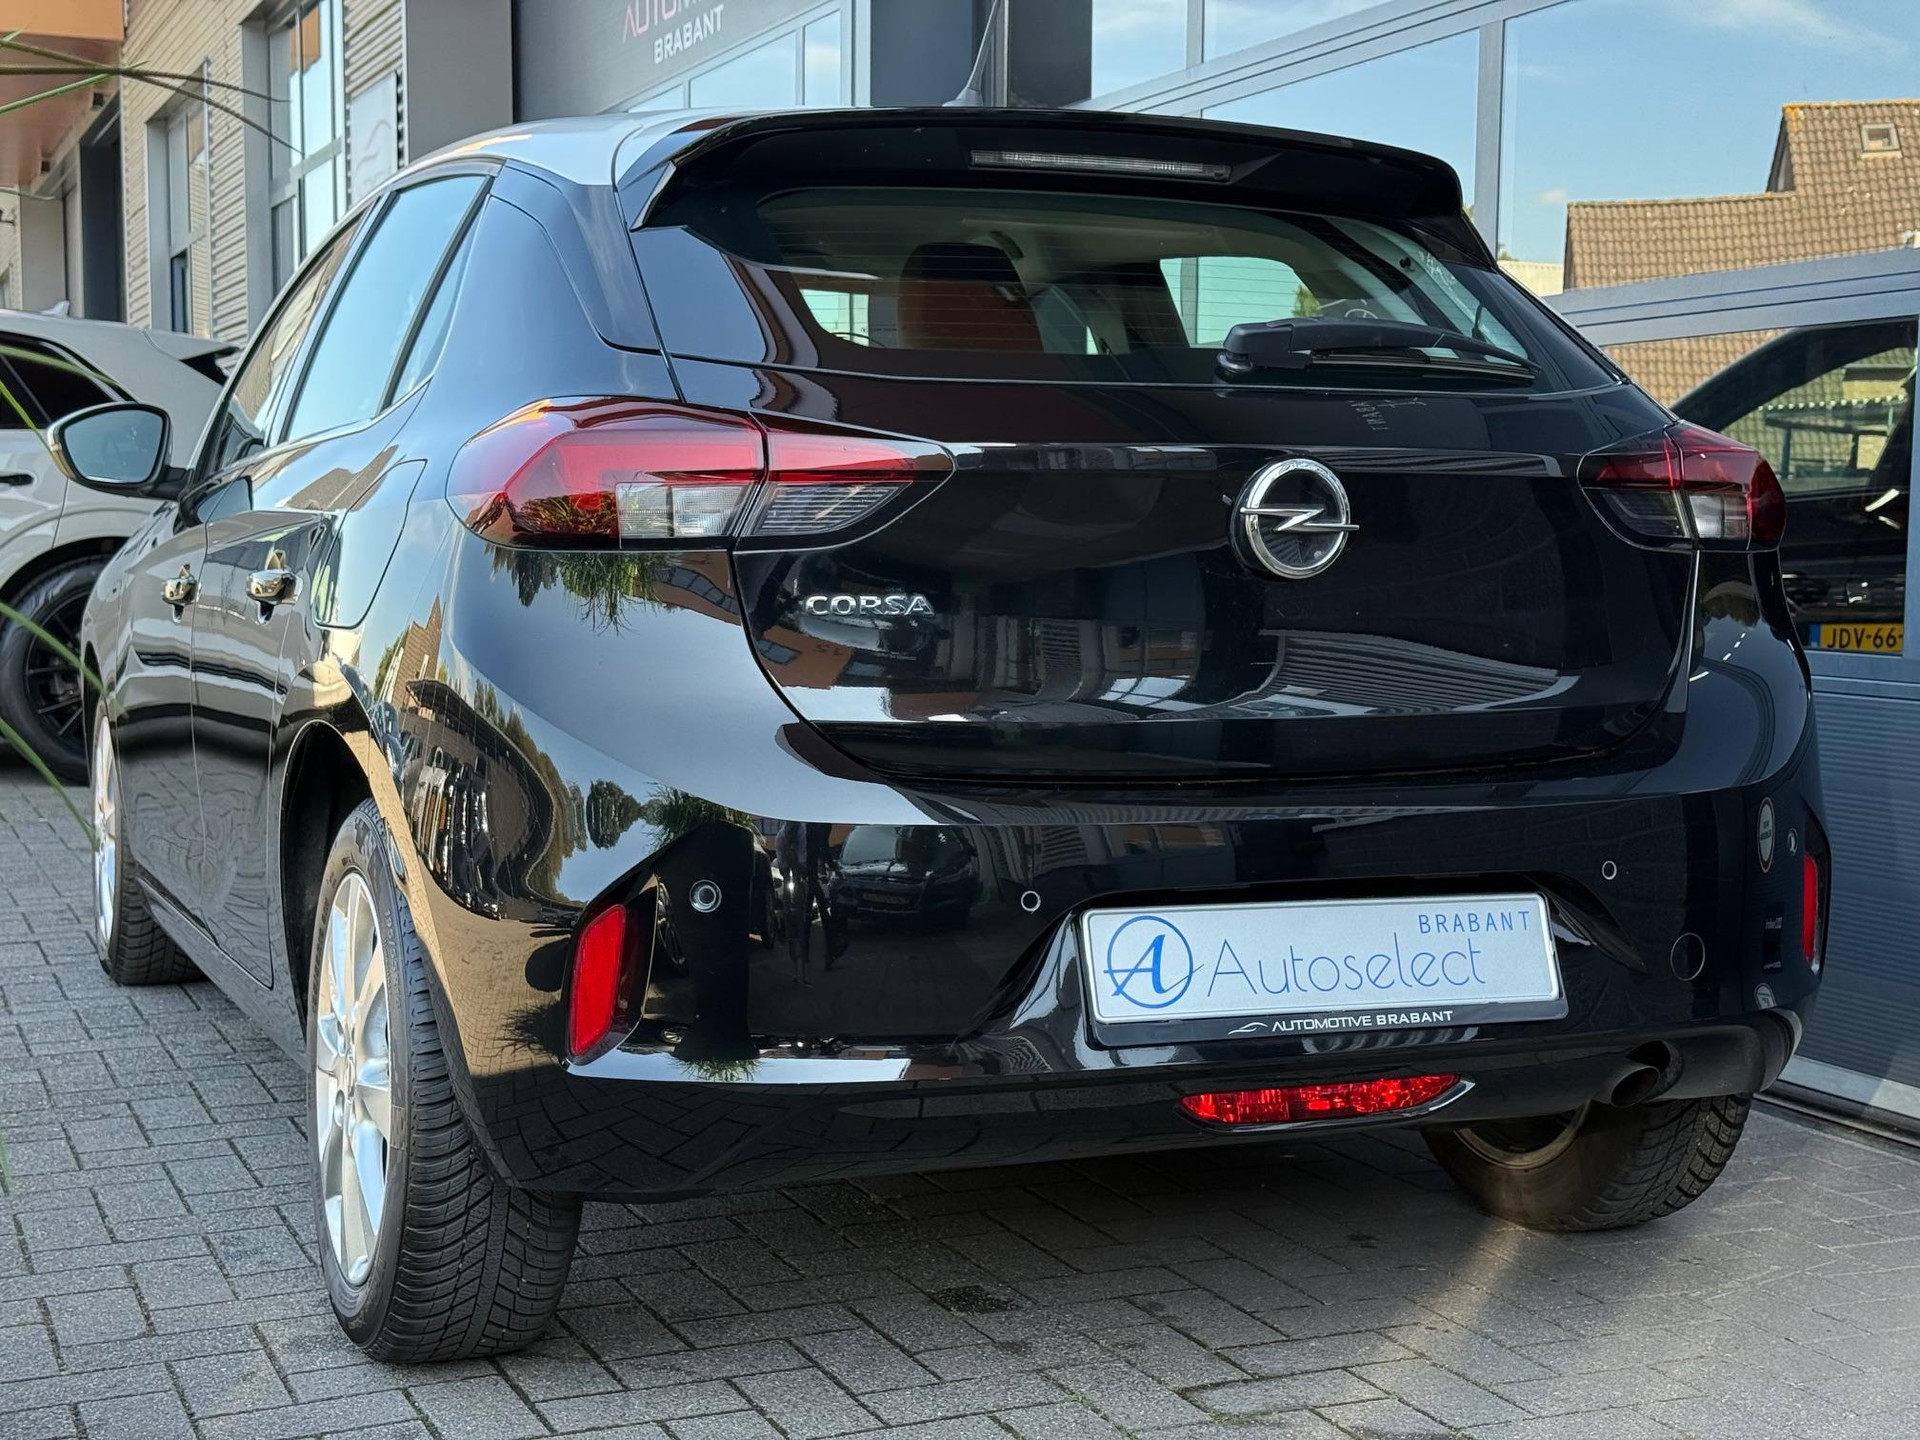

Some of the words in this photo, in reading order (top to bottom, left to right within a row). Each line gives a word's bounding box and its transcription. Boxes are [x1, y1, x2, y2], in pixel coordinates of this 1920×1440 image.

[654, 4, 724, 64] BRABANT
[805, 595, 936, 616] CORSA
[1418, 911, 1529, 934] BRABANT
[1207, 932, 1486, 997] Autoselect
[1271, 1016, 1373, 1033] AUTOMOTIVE
[1376, 1010, 1454, 1026] BRABANT
